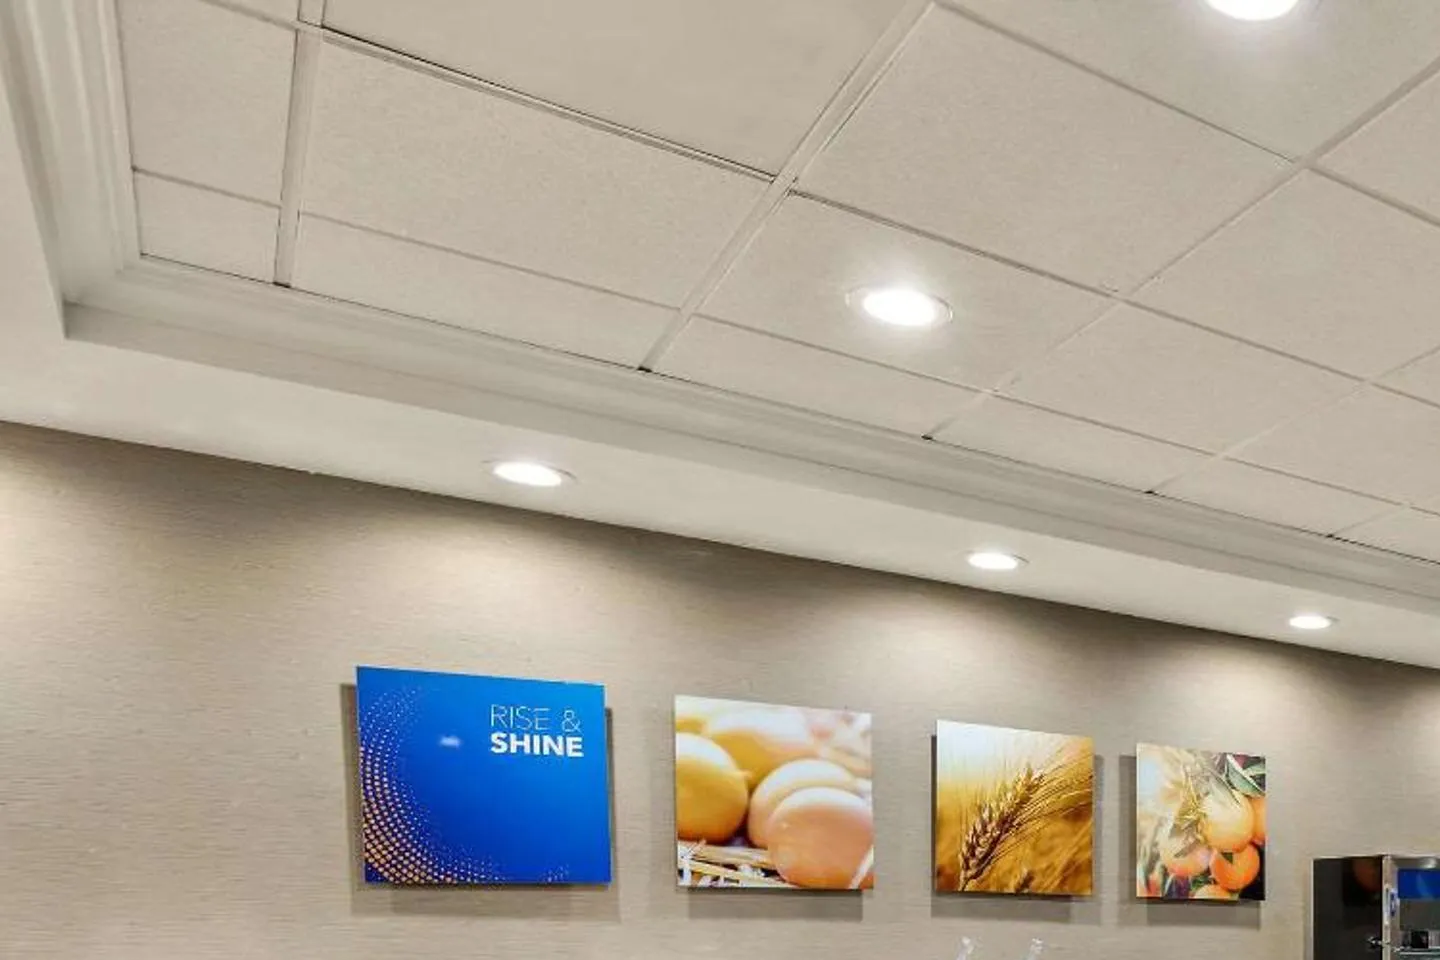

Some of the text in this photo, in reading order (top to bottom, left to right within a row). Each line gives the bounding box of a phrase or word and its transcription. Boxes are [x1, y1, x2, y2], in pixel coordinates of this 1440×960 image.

[490, 704, 582, 733] RISE &
[490, 731, 585, 758] SHINE
